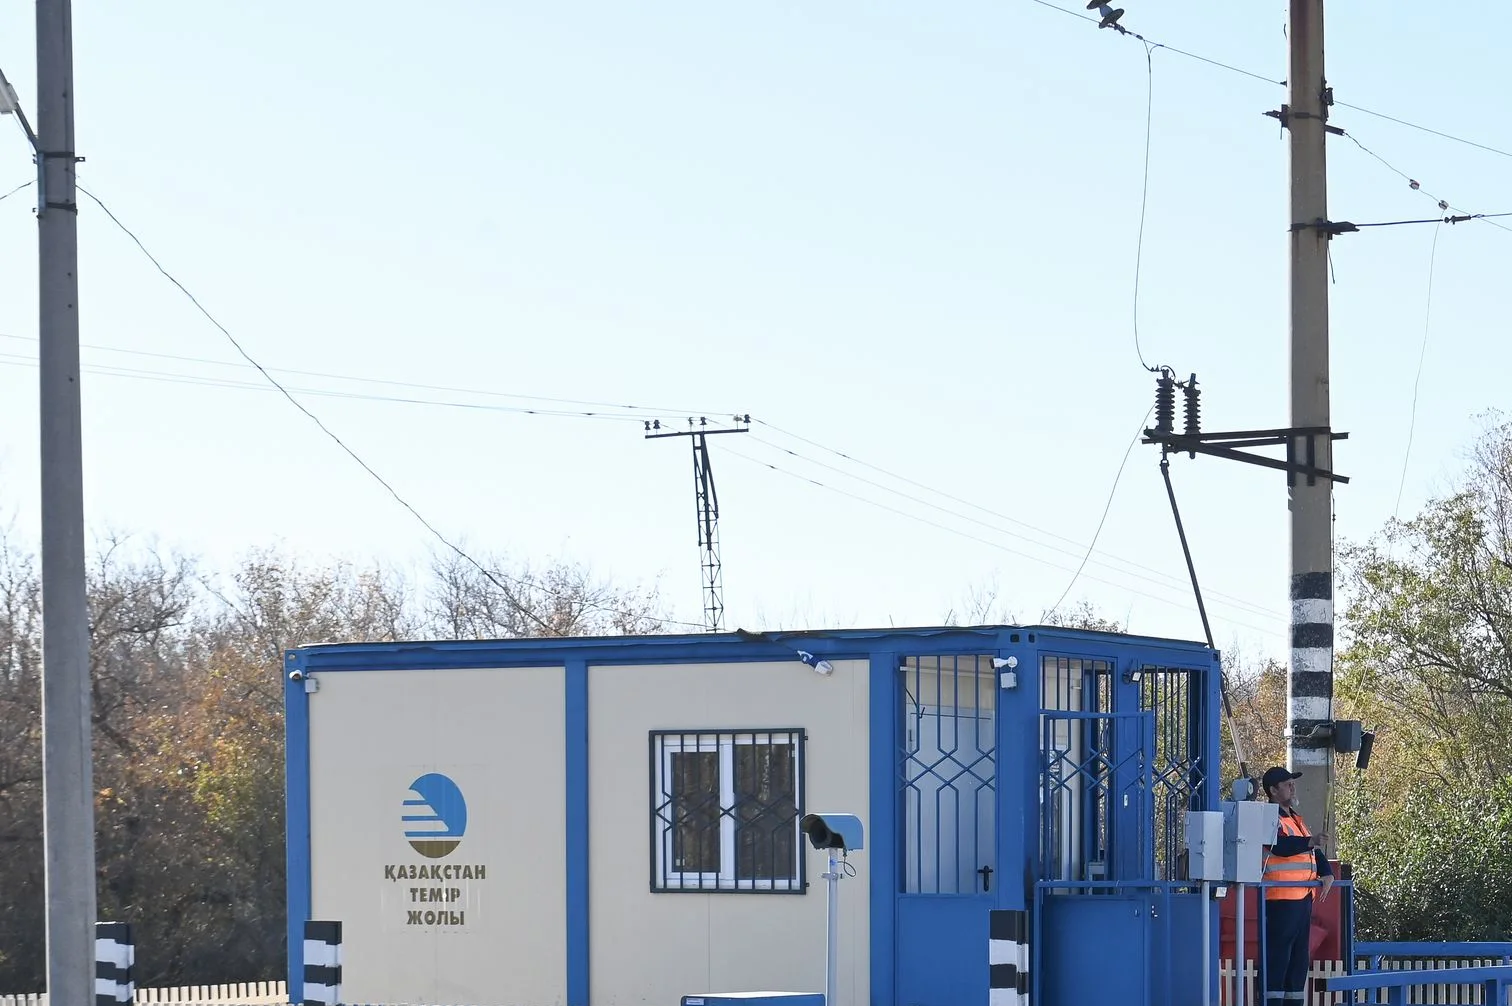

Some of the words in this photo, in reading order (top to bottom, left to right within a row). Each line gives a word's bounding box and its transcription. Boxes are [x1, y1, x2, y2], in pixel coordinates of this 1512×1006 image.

[385, 864, 486, 882] ҚАЗАҚСТАН
[410, 887, 461, 902] ТЕМІР
[406, 910, 465, 925] ЖОЛЫ
